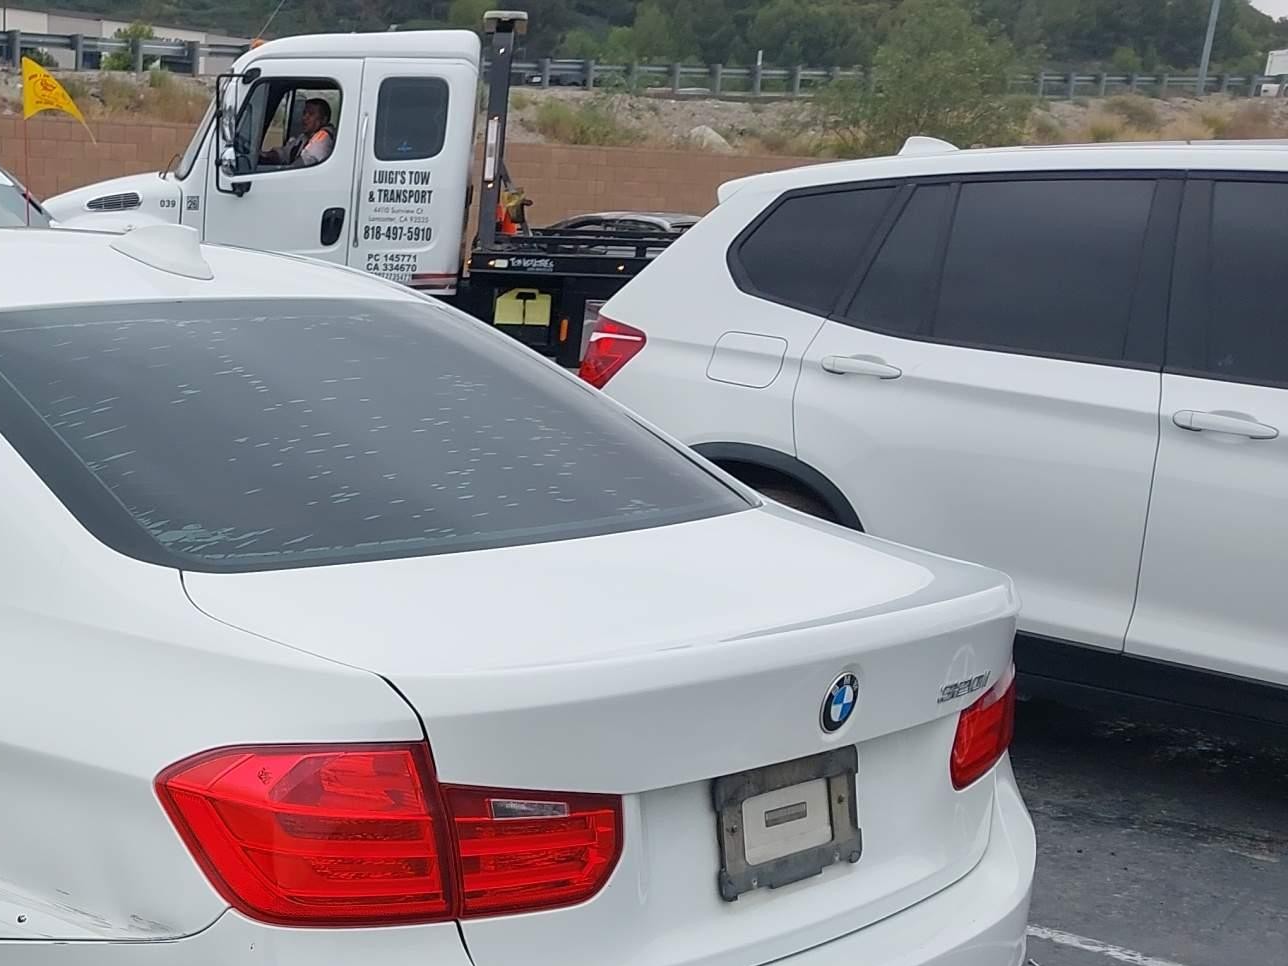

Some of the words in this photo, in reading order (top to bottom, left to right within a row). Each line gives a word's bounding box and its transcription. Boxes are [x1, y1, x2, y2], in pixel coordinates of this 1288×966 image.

[373, 170, 407, 185] LUIGI'S
[409, 171, 431, 186] TOW
[368, 190, 375, 203] &
[377, 189, 434, 204] TRANSPORT
[159, 199, 176, 209] 039
[363, 225, 433, 242] 818-497-5910
[367, 253, 380, 262] PC
[383, 254, 417, 263] 145771
[366, 262, 380, 271] CA
[382, 263, 418, 272] 334670
